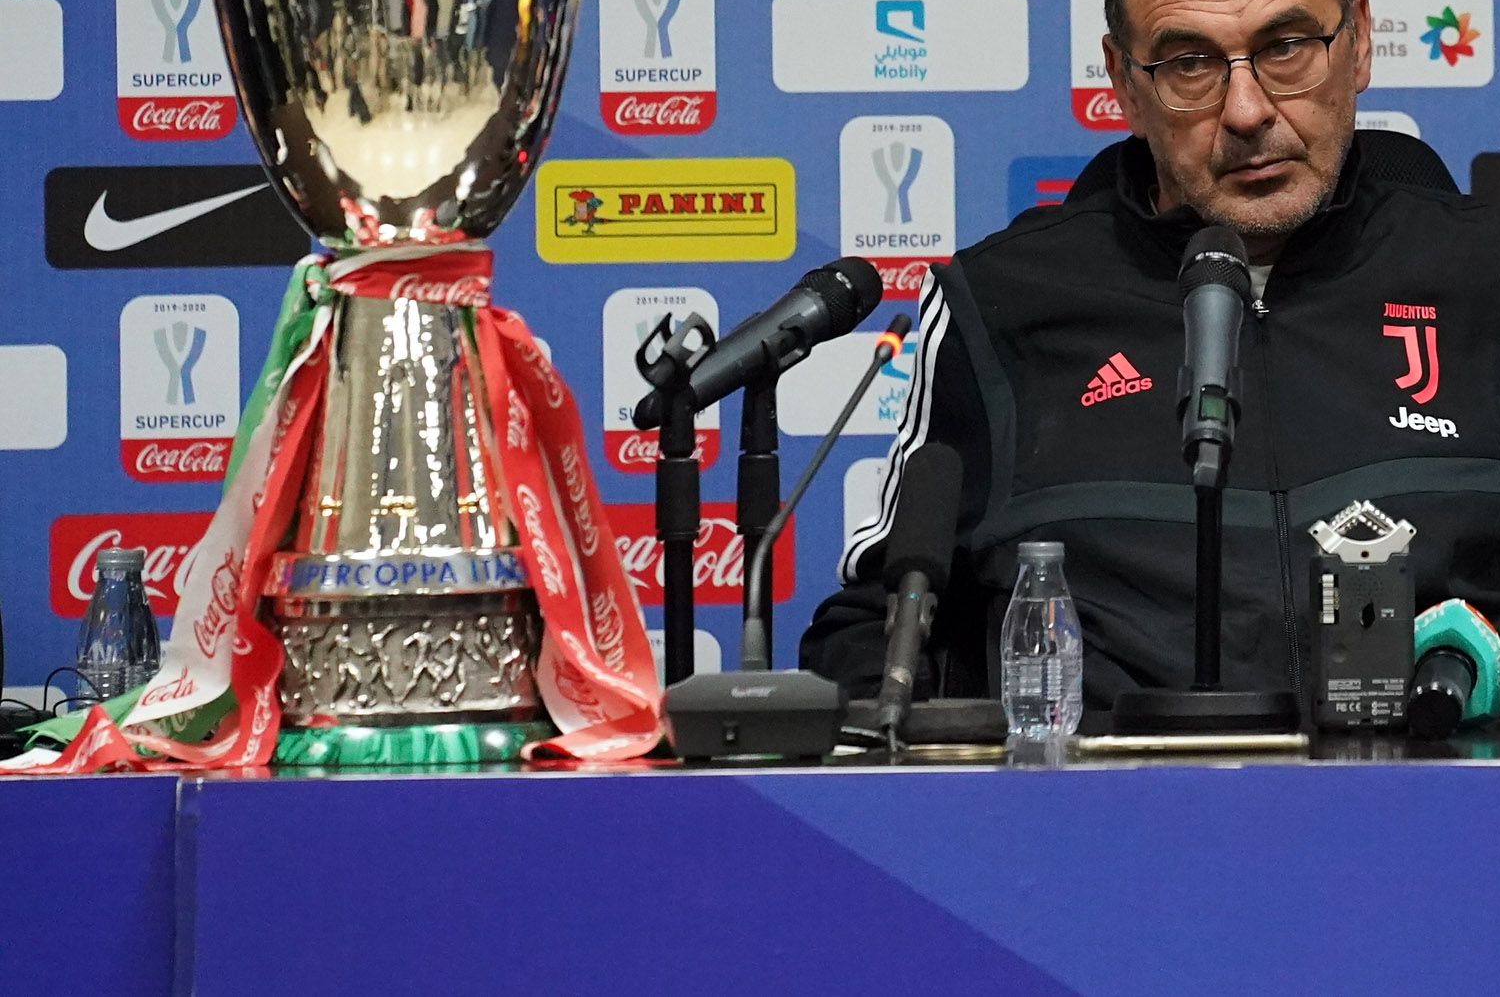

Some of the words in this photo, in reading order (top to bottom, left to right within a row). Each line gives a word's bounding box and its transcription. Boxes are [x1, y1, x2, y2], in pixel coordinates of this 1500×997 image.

[615, 69, 701, 82] SUPERCUP
[874, 66, 926, 80] Mobily
[132, 74, 221, 87] SUPERCUP
[618, 192, 766, 216] PANINI
[855, 234, 941, 247] SUPERCUP
[1384, 302, 1437, 320] JUVENTUS
[1080, 376, 1154, 408] adidas
[135, 415, 225, 429] SUPERCUP
[1388, 407, 1459, 438] Jeep
